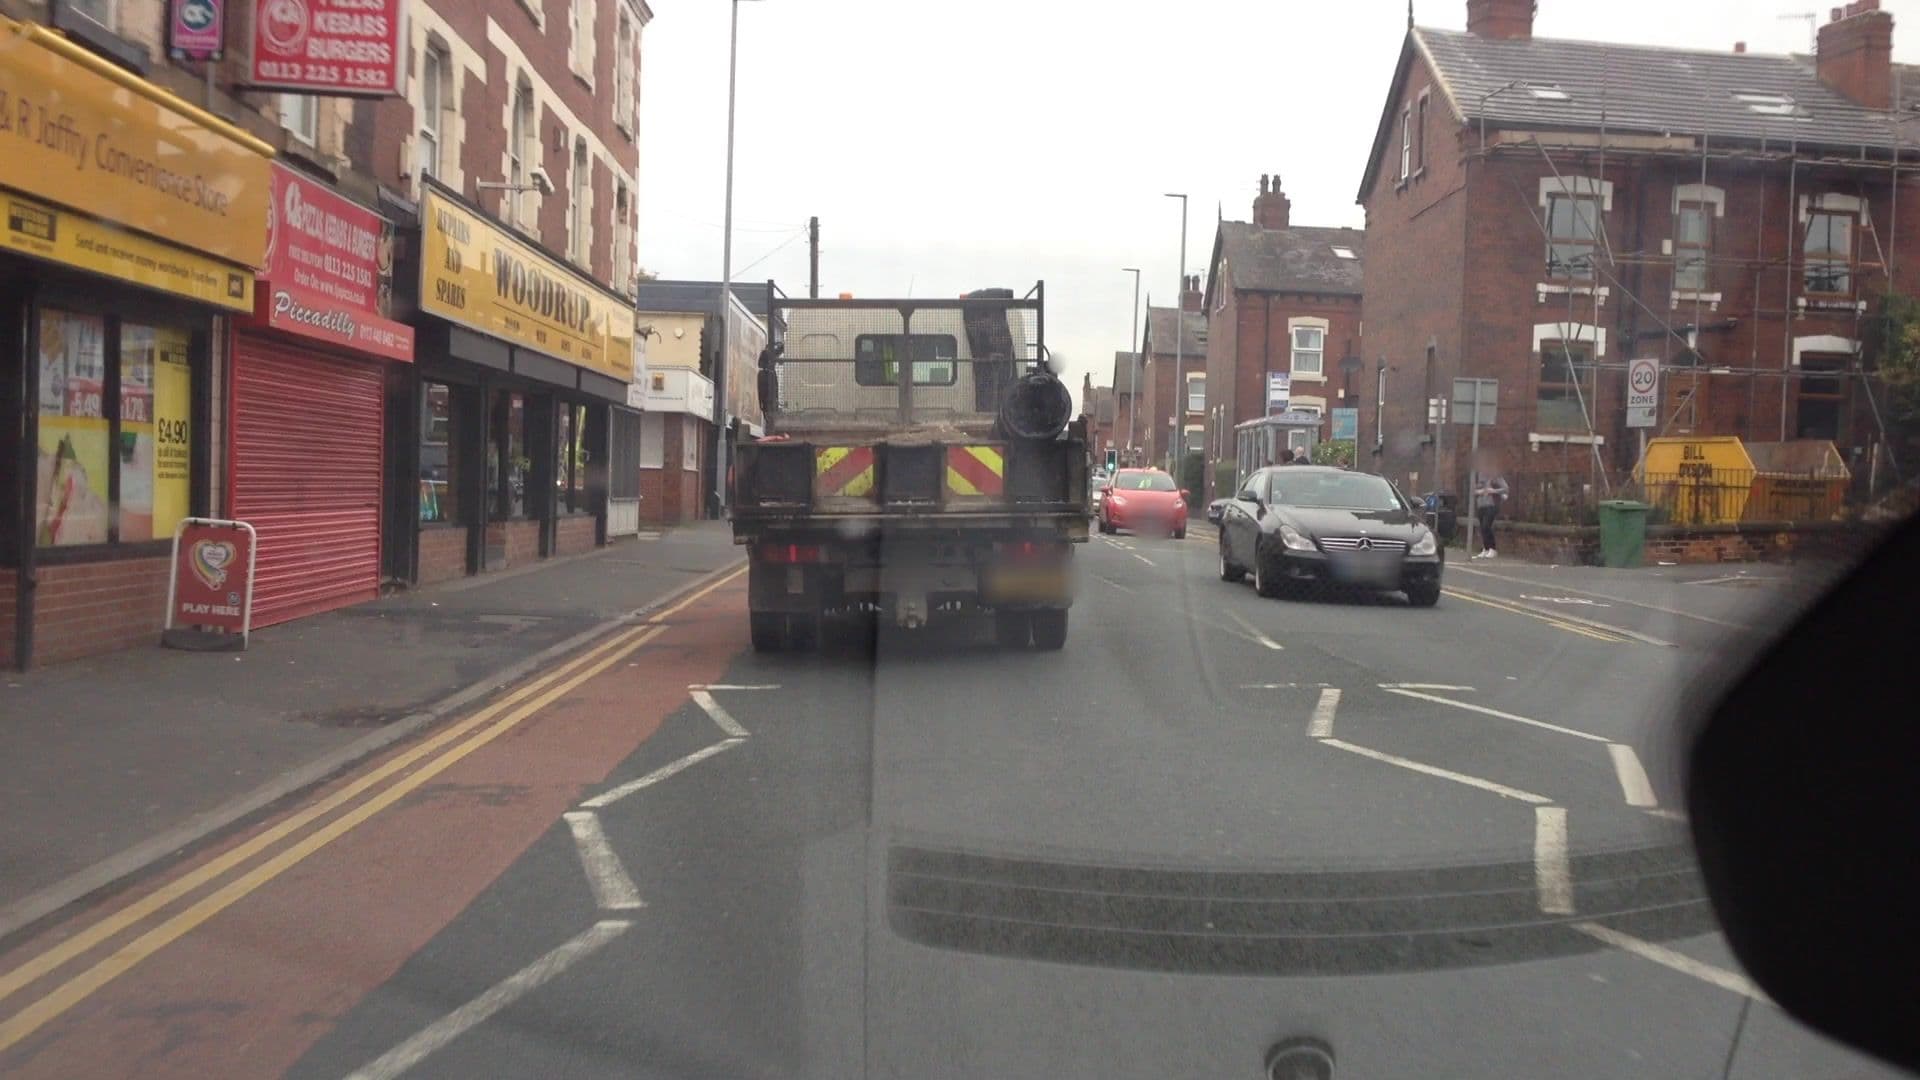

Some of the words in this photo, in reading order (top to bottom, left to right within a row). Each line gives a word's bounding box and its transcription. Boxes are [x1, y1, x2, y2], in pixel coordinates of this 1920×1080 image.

[313, 11, 388, 37] KEBABS
[306, 37, 391, 63] BURGERS
[258, 60, 301, 79] 0113
[306, 64, 339, 82] 225
[345, 68, 387, 85] 1582
[95, 132, 194, 203] Convenience
[194, 174, 228, 216] Store
[444, 247, 462, 275] AND
[436, 277, 466, 310] SPARES
[493, 247, 590, 333] WOODRUP
[274, 291, 356, 340] Piccadilly
[1635, 370, 1653, 385] 20
[1630, 395, 1655, 404] ZONE
[158, 417, 187, 444] £4.90
[1684, 445, 1704, 460] BILL
[1679, 463, 1713, 478] DYSON
[182, 603, 210, 614] PLAY
[212, 605, 240, 616] HERE
